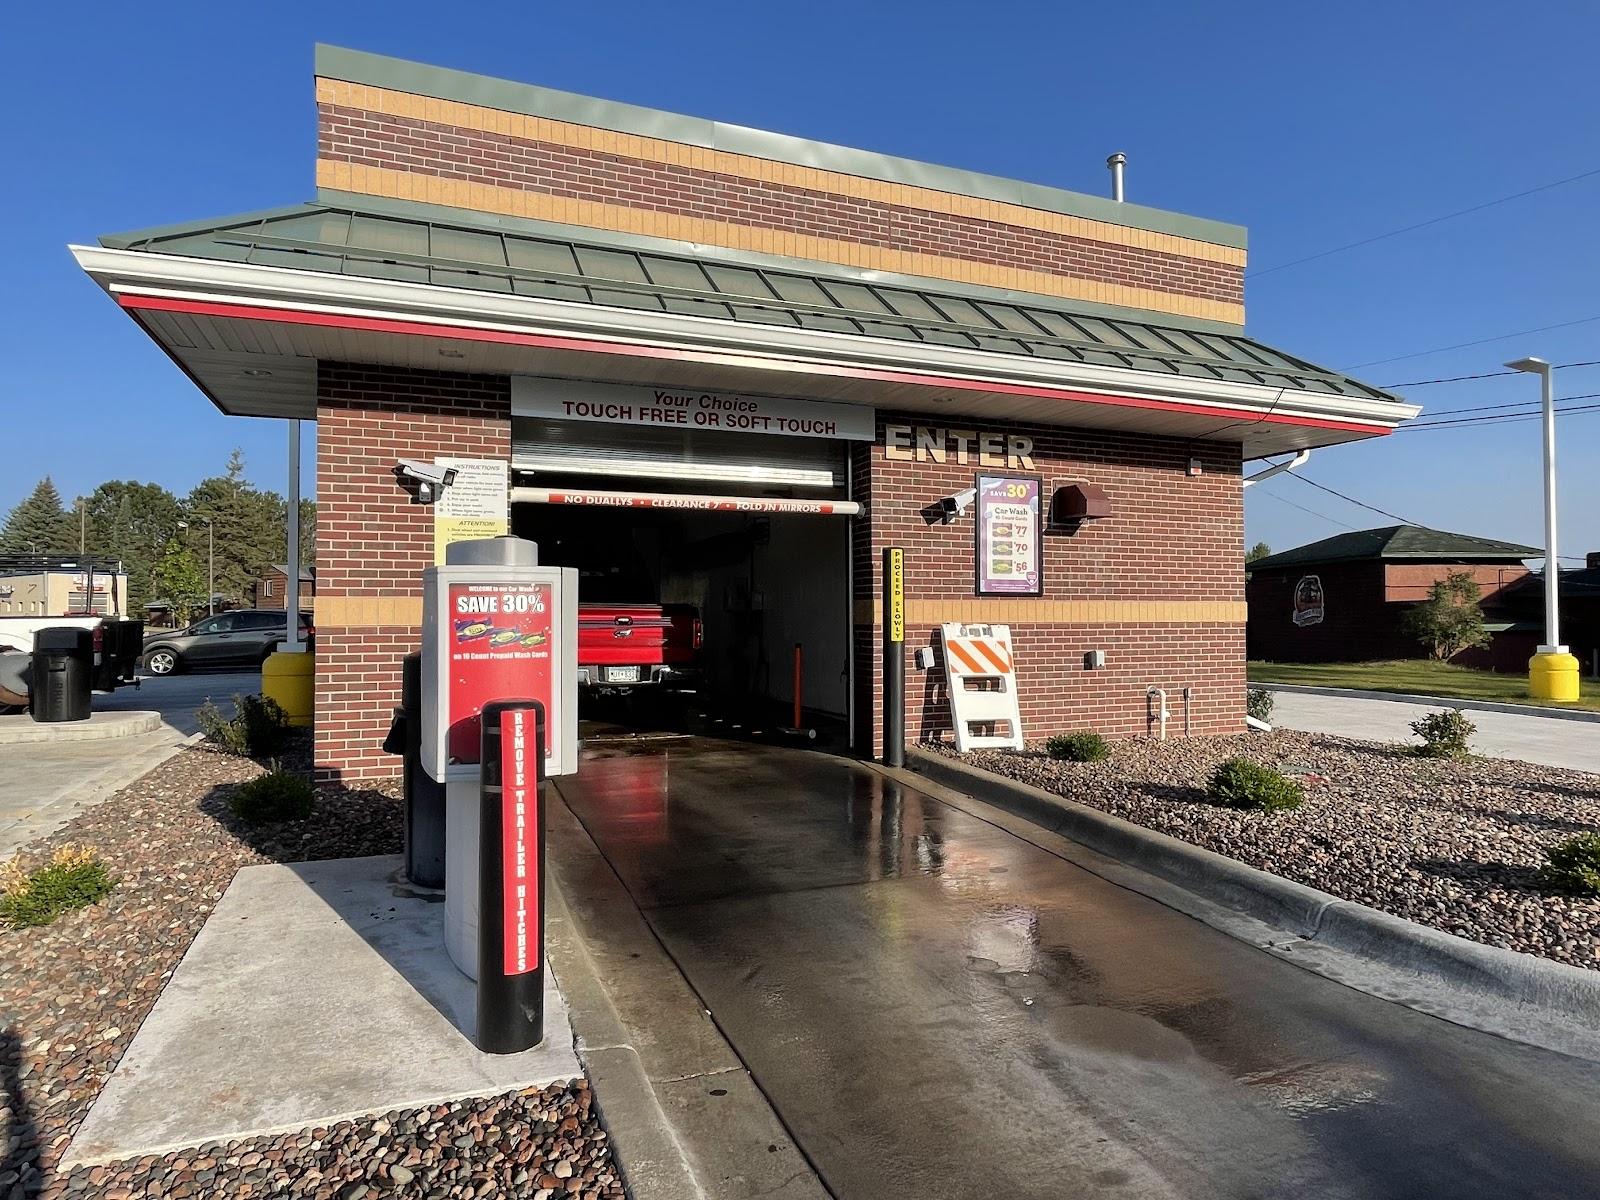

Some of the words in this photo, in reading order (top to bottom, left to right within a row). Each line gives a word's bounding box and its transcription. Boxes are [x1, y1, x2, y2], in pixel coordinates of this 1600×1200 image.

[654, 390, 694, 407] Your
[698, 395, 758, 412] Choice
[562, 401, 632, 420] TOUCH
[639, 407, 688, 424] FREE
[694, 411, 720, 426] OR
[725, 413, 771, 430] SOFT
[776, 417, 836, 434] TOUCH
[885, 425, 1034, 469] ENTER
[564, 495, 584, 504] NO
[586, 496, 633, 506] DUALLYS
[651, 499, 710, 509] CLEARANCE
[736, 501, 761, 511] FOLD
[763, 502, 776, 512] IN
[778, 503, 822, 513] MIRRORS
[994, 507, 1009, 515] Car
[1009, 507, 1028, 516] Wash
[457, 597, 497, 612] SAVE
[503, 594, 544, 613] 30%
[893, 601, 902, 639] SLOWLY
[489, 652, 514, 660] Prepaid
[513, 712, 525, 787] REMOVE
[515, 790, 526, 877] TRAILER
[516, 884, 527, 972] HITCHES
